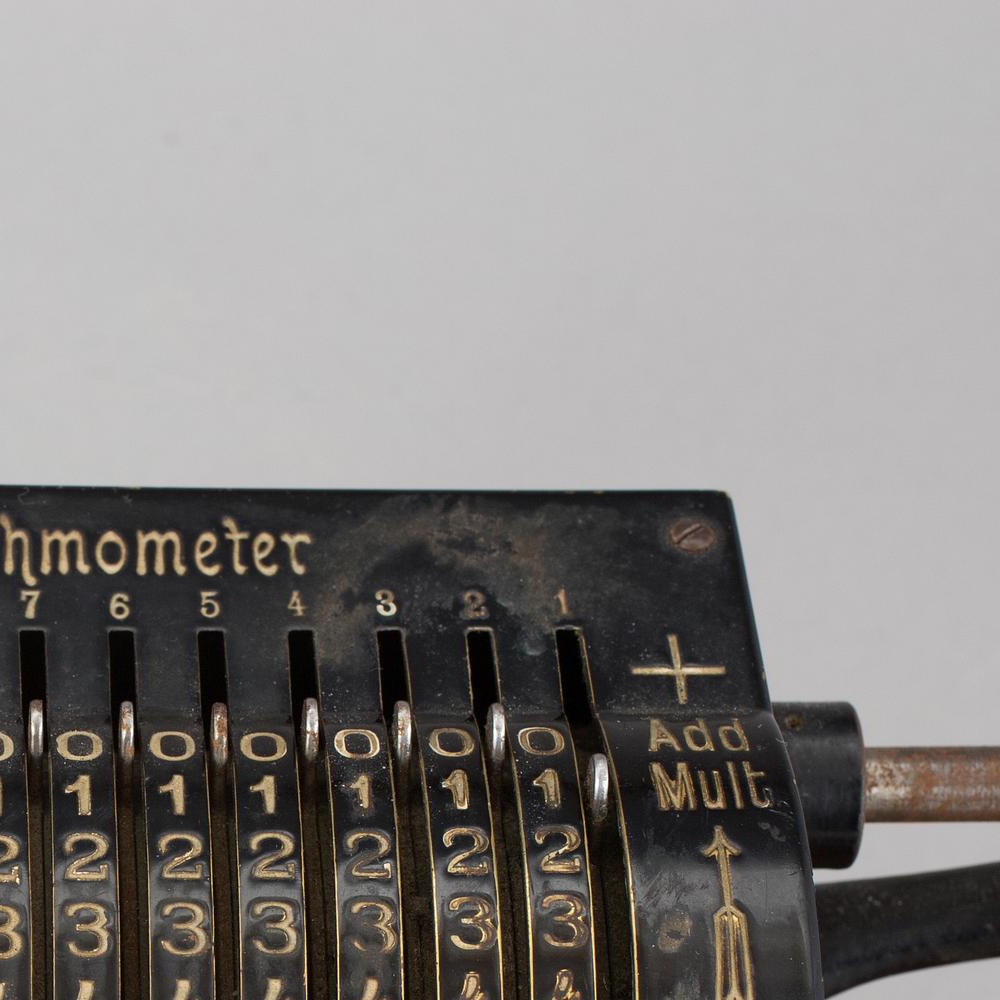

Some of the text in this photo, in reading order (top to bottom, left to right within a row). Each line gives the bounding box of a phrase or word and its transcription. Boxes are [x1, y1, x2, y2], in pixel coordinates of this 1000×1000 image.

[20, 590, 40, 619] 7
[108, 593, 130, 620] 6
[200, 591, 221, 618] 5
[288, 591, 307, 616] 4
[375, 589, 398, 616] 3
[556, 588, 569, 615] 1
[56, 730, 102, 761] 0
[149, 731, 195, 761] 0
[240, 731, 287, 761] 0
[334, 729, 380, 759] 0
[429, 728, 475, 758] 0
[518, 727, 564, 756] 0
[648, 718, 749, 751] Add
[65, 775, 92, 816] 1
[159, 775, 185, 815] 1
[250, 775, 276, 814] 1
[350, 775, 370, 809] 1
[441, 770, 469, 809] 1
[533, 769, 560, 807] 1
[64, 833, 108, 882] 2
[158, 833, 204, 880] 2
[249, 830, 295, 879] 2
[344, 832, 391, 879] 2
[442, 827, 489, 875] 2
[534, 825, 581, 874] 2
[65, 903, 108, 957] 3
[160, 902, 207, 956] 3
[252, 902, 297, 954] 3
[350, 901, 396, 954] 3
[449, 896, 497, 950] 3
[541, 895, 588, 948] 3
